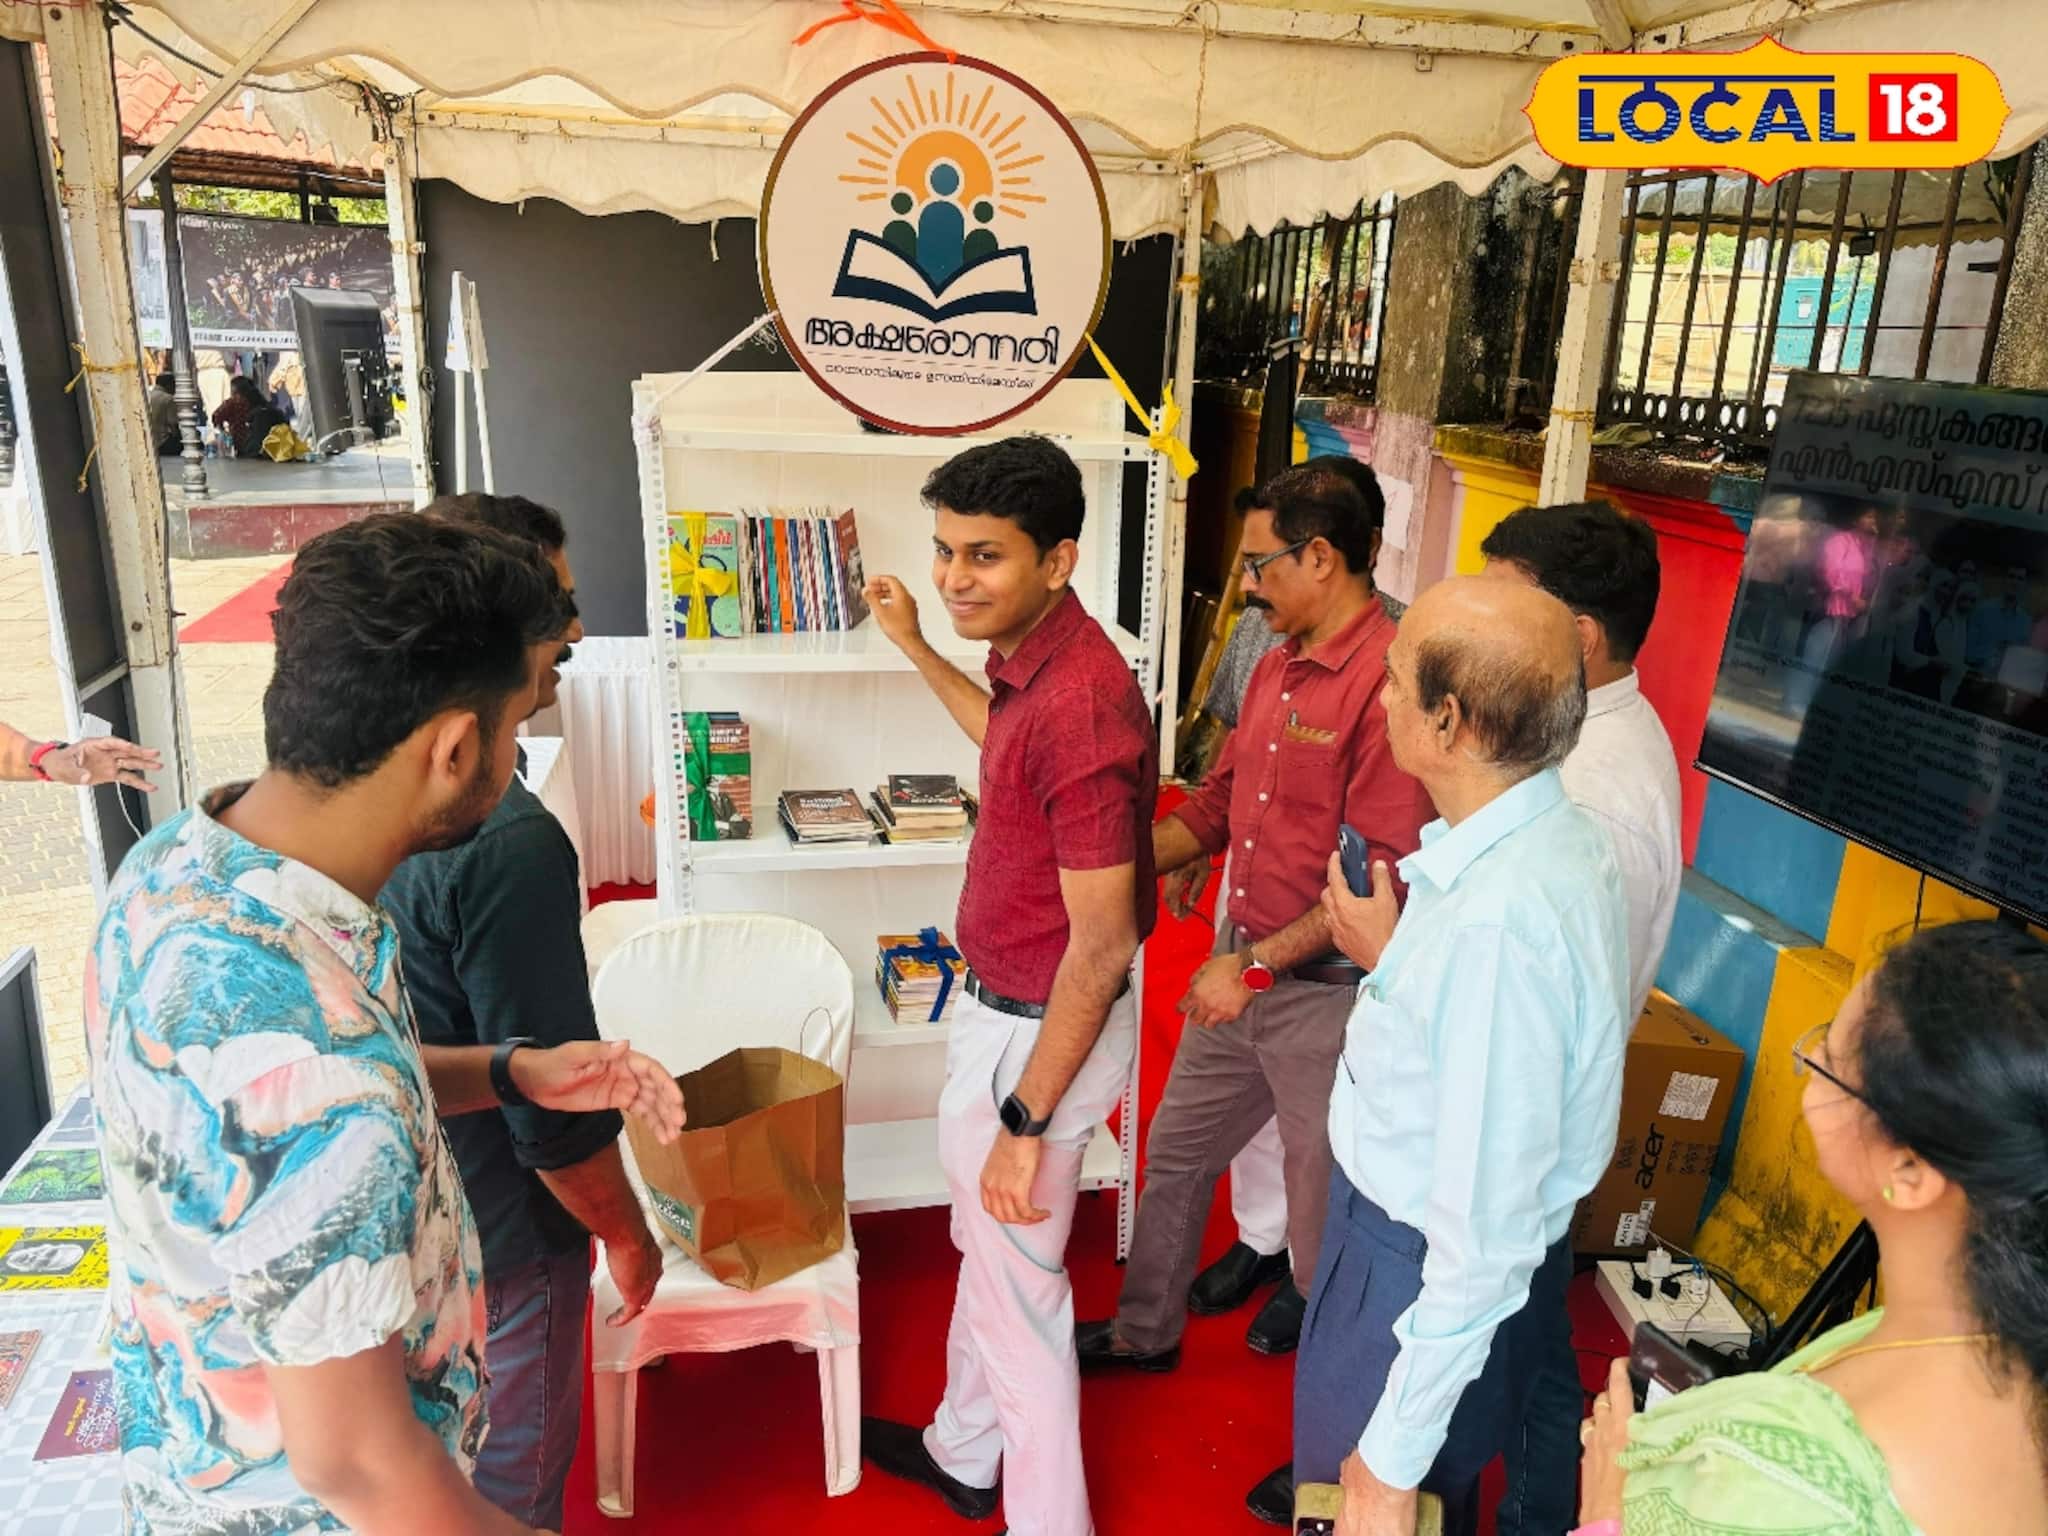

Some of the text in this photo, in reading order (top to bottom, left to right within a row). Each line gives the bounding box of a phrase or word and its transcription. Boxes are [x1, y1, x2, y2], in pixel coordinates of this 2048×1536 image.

[805, 318, 1060, 365] അക്ഷരോന്നതി
[1856, 402, 2048, 457] പുസ്തകങ്ങ
[1779, 442, 2042, 510] എൻഎസ്എസ്
[1635, 1122, 1665, 1189] acer
